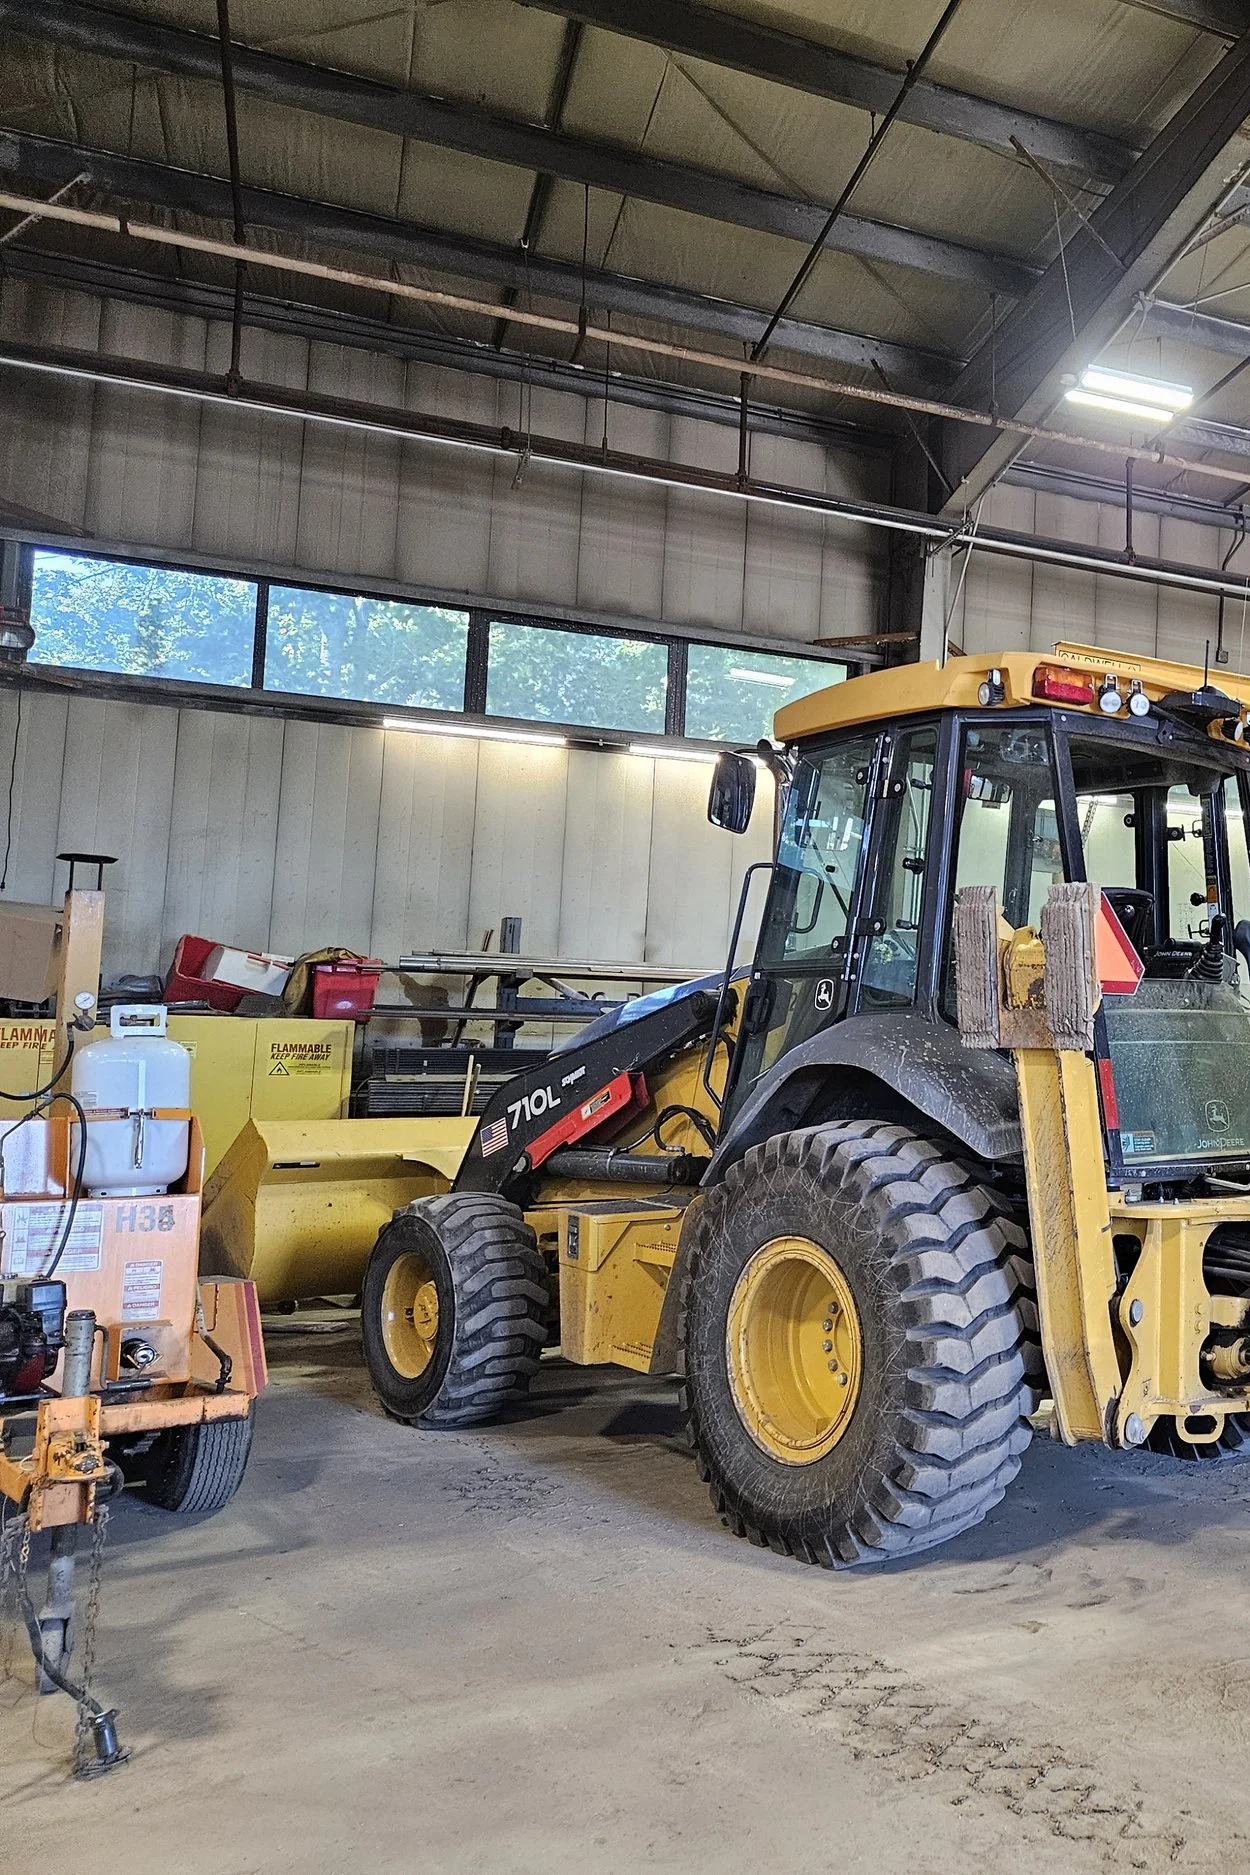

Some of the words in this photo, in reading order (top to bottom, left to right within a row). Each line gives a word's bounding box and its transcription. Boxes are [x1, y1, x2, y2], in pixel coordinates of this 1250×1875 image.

[271, 1043, 332, 1054] FLAMMABLE
[507, 1085, 561, 1130] 710L
[1197, 1139, 1219, 1148] JOHN
[1219, 1137, 1245, 1150] DEERE
